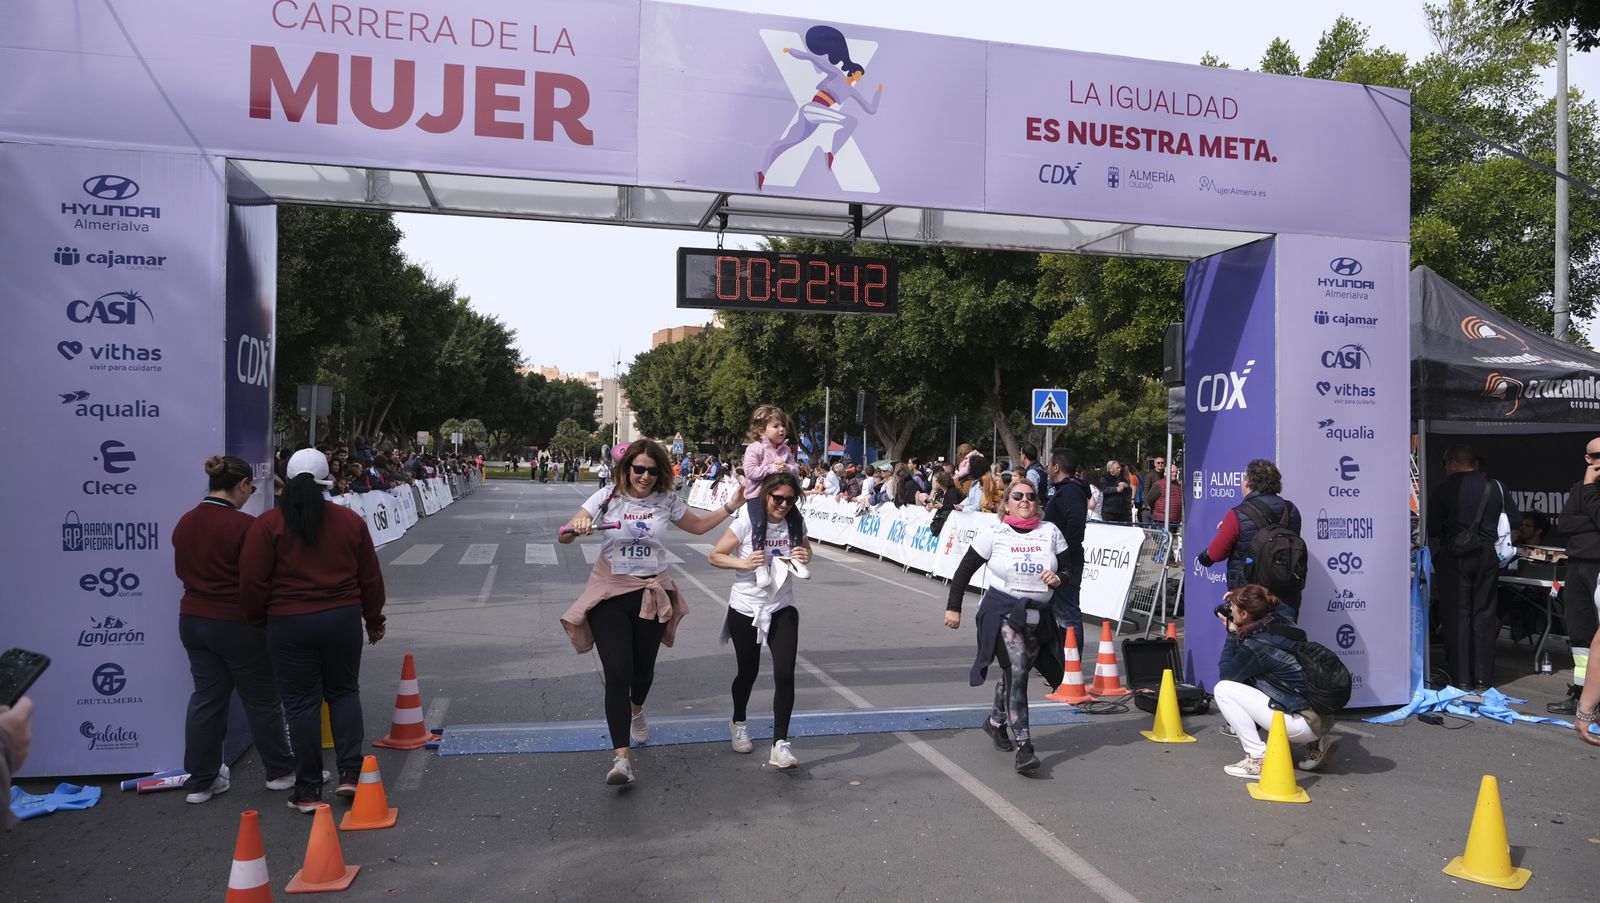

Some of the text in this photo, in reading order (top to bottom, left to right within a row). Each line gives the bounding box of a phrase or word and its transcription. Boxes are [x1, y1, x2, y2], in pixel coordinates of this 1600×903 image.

[271, 0, 577, 57] CARRERA DE LA
[248, 44, 595, 146] MUJER
[1069, 80, 1239, 121] LA IGUALDAD
[1026, 116, 1278, 163] ES NUESTRA META.
[1039, 162, 1083, 186] CDX
[1129, 169, 1176, 184] ALMERÍA
[61, 202, 161, 219] HYUNDAI
[74, 219, 150, 233] Almerialva
[86, 250, 167, 268] cajamar
[716, 256, 888, 307] 00:22:42
[1317, 278, 1375, 290] HYUNDAI
[1325, 290, 1369, 300] Almerialva
[66, 299, 136, 325] CASI
[1332, 313, 1379, 327] cajamar
[90, 343, 162, 361] vithas
[1321, 350, 1362, 369] CASI
[128, 364, 162, 372] cuidarte
[1197, 360, 1256, 413] CDX
[1334, 383, 1376, 397] vithas
[75, 400, 160, 421] aqualia
[1325, 425, 1375, 442] aqualia
[82, 480, 137, 495] Clece
[1210, 488, 1235, 498] CIUDAD
[1328, 486, 1360, 497] Clece
[114, 522, 159, 551] CASH
[1346, 517, 1373, 539] CASH
[84, 537, 114, 551] PIEDRA
[620, 546, 651, 557] 1150
[1013, 563, 1044, 574] 1059
[1327, 551, 1362, 575] ego
[79, 567, 140, 598] ego
[1327, 598, 1366, 612] Lanjarón
[77, 629, 145, 647] Lanjarón
[77, 697, 143, 705] GRUTALMERIA
[80, 720, 138, 751] Galatea
